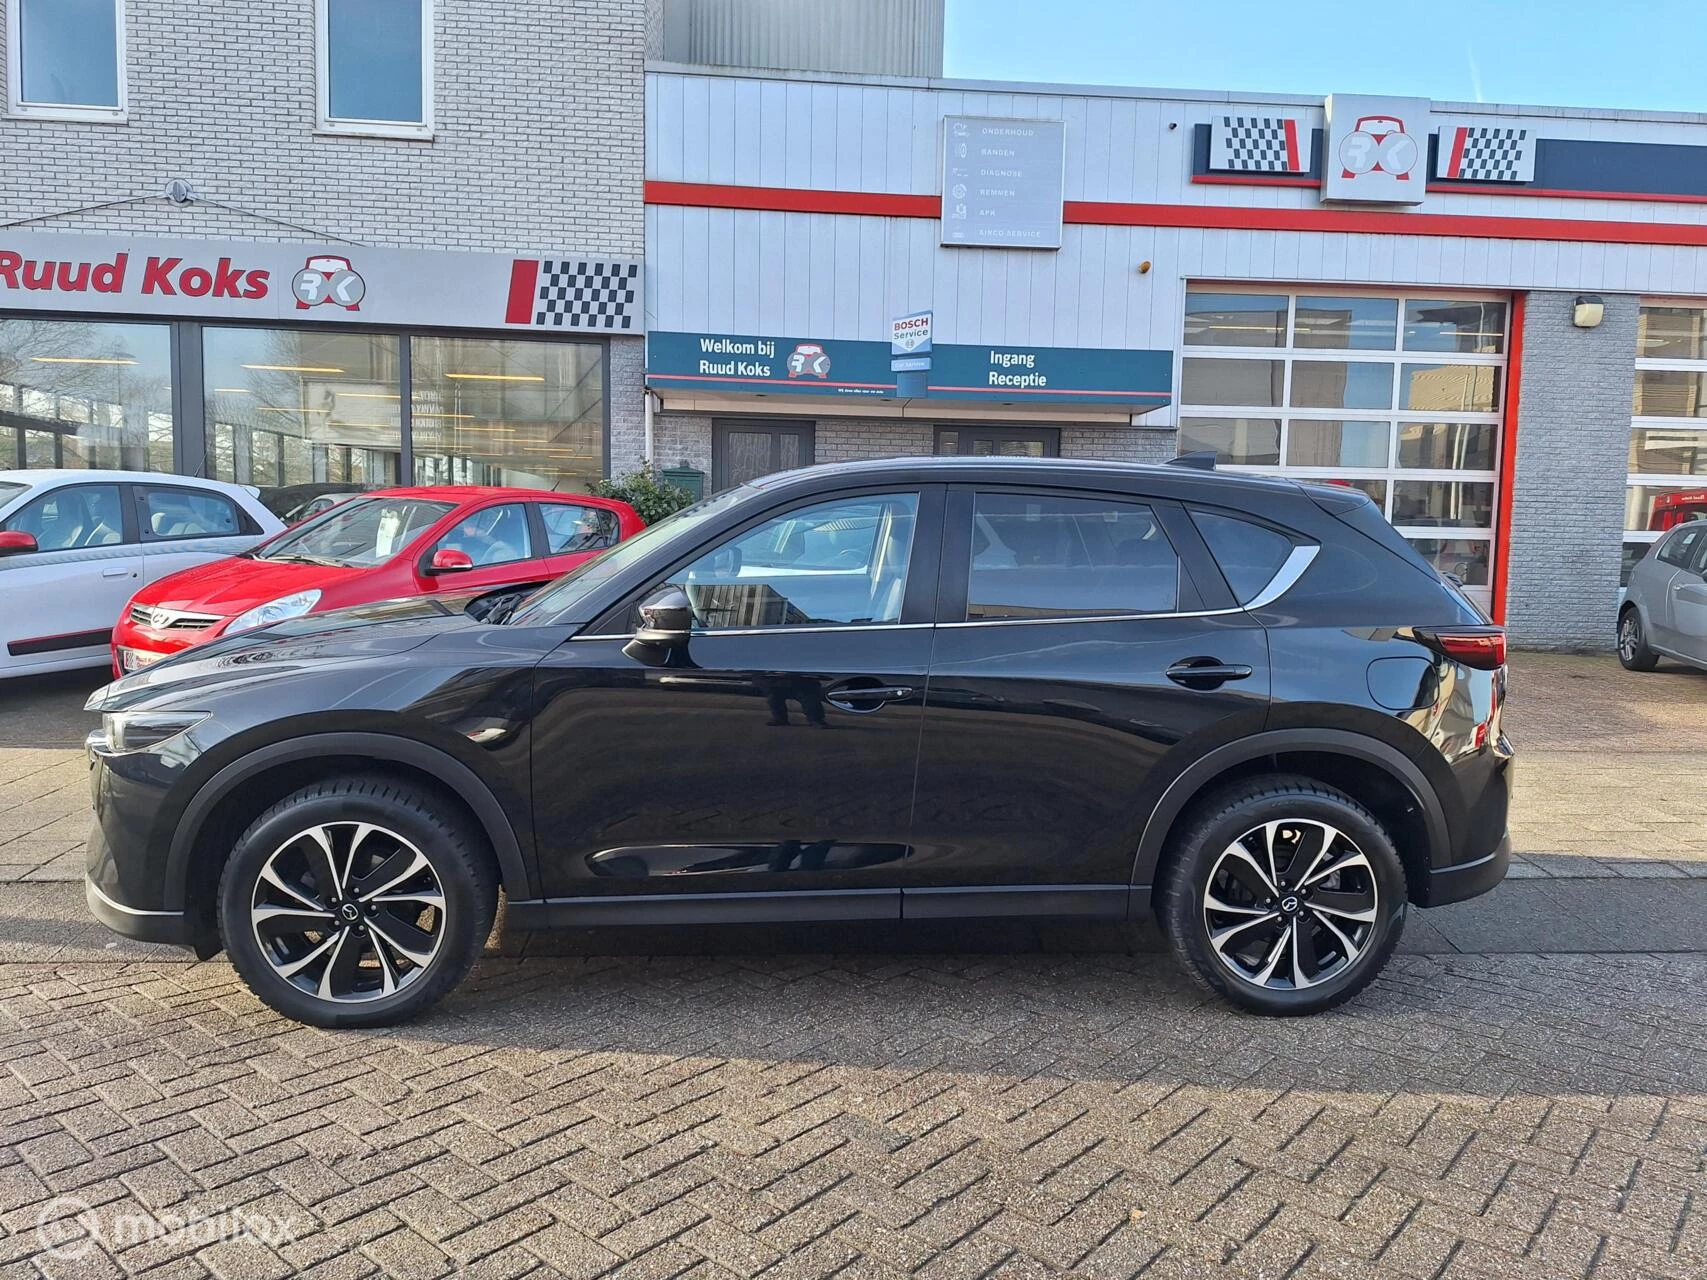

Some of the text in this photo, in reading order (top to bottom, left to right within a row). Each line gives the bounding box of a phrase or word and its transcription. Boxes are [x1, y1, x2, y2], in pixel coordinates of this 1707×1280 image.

[982, 127, 1034, 137] ONDERHOUD
[980, 169, 1022, 177] DIAGNOSE
[0, 250, 270, 299] Ruud Koks
[894, 317, 929, 331] BOSCH
[894, 329, 929, 340] Service
[700, 338, 775, 358] Welkom bij
[699, 359, 771, 376] Ruud Koks
[990, 350, 1035, 368] Ingang
[989, 371, 1047, 389] Receptie
